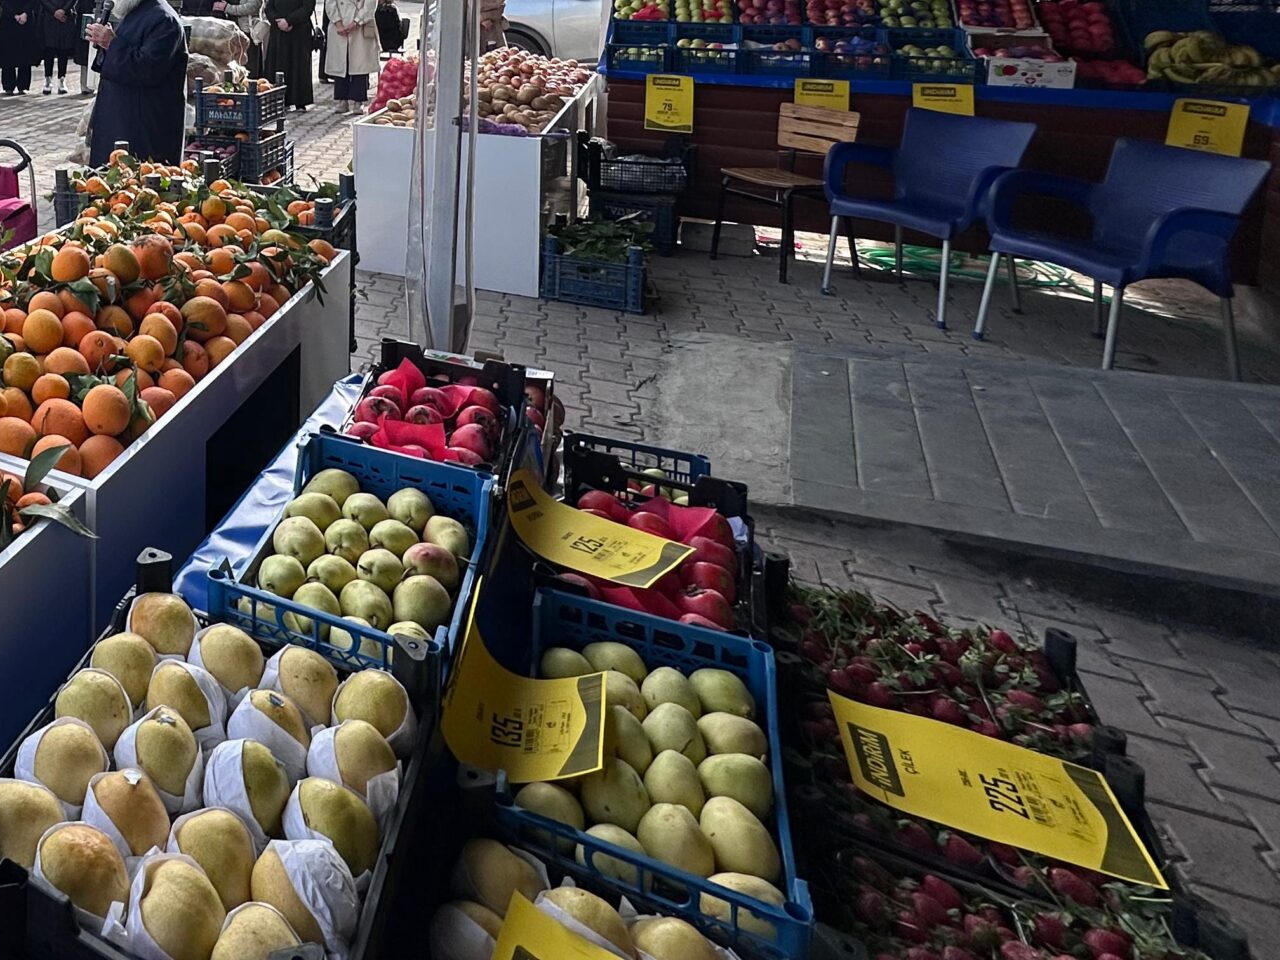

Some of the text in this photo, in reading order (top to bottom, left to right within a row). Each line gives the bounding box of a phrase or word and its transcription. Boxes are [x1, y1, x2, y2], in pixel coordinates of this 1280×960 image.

[569, 536, 605, 555] 125
[490, 711, 524, 747] 135
[898, 747, 920, 776] ÇİLEK
[977, 772, 1031, 820] 225
